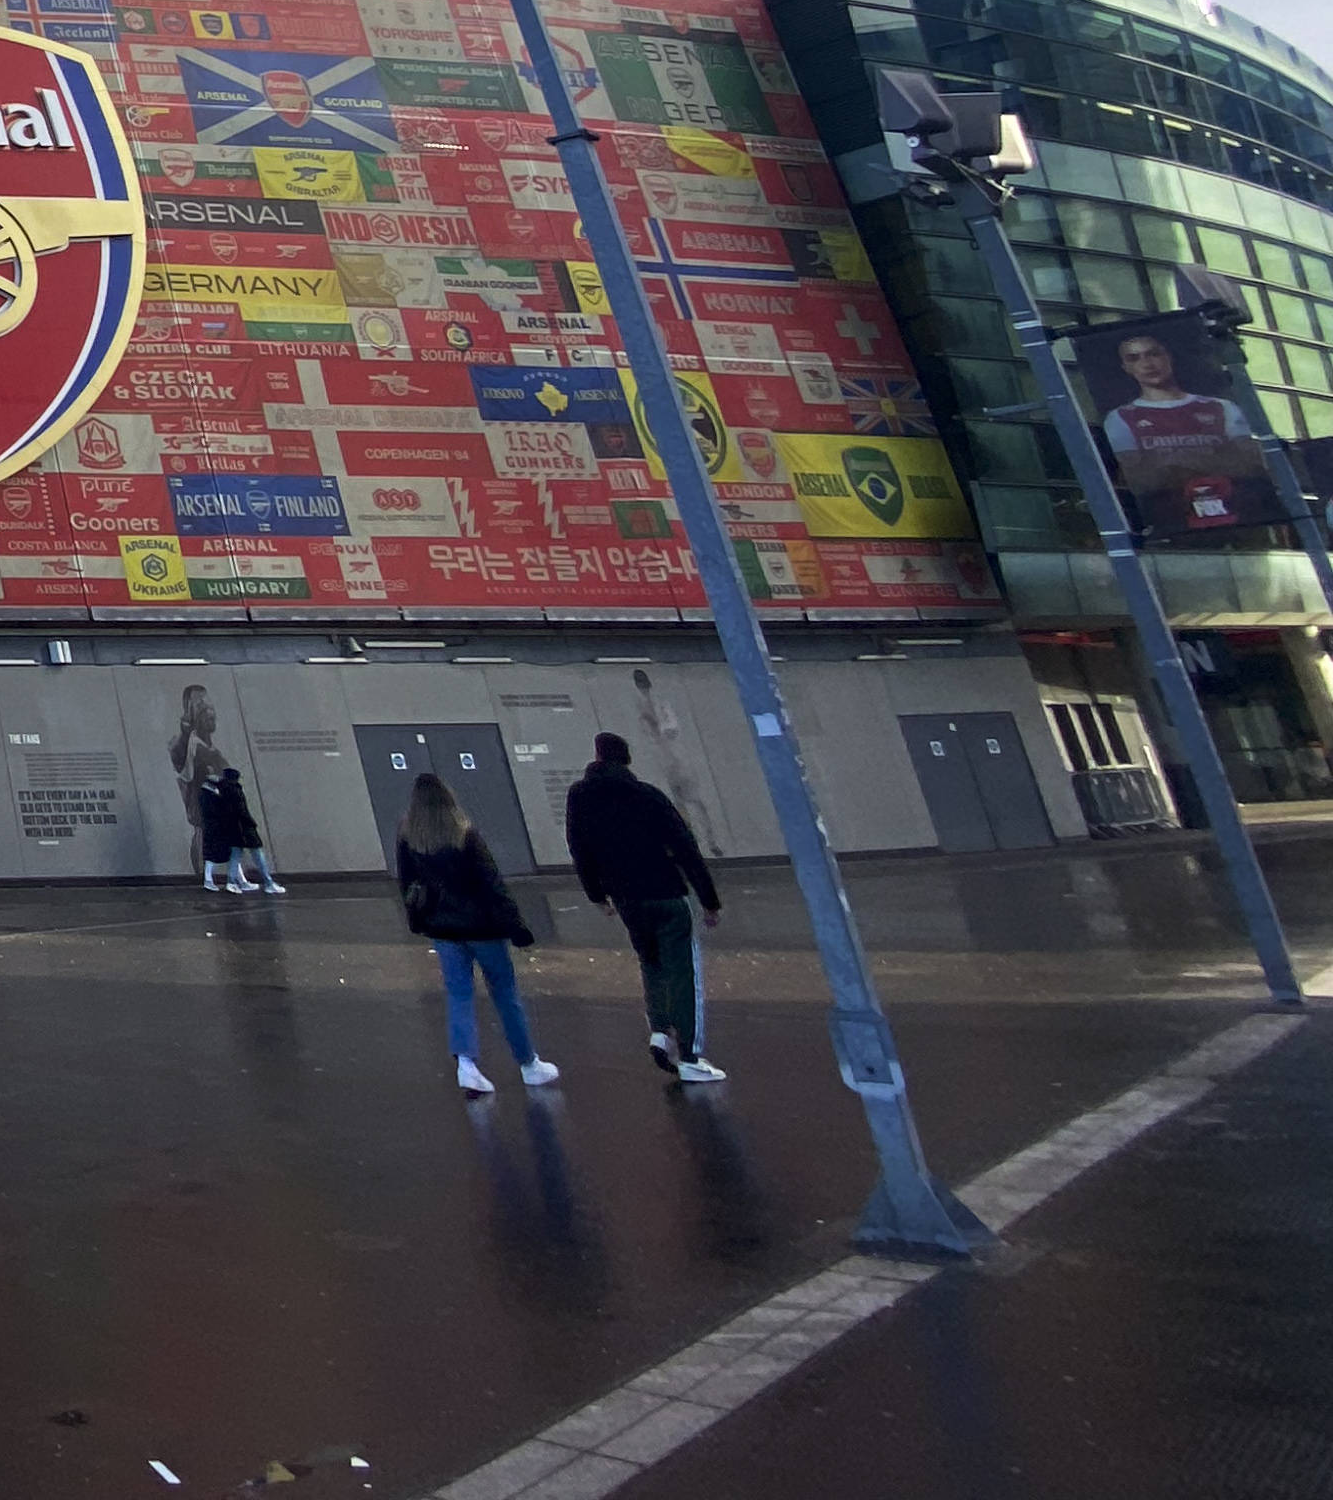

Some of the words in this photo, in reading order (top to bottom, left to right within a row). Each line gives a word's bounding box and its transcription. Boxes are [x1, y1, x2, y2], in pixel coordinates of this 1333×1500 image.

[370, 27, 455, 43] YORKSHIRE
[282, 151, 326, 164] ARSENAL
[142, 271, 323, 296] GERMANY
[701, 292, 796, 315] NORWAY
[425, 309, 478, 323] ARSENAL
[517, 316, 592, 330] ARSENAL
[195, 343, 231, 354] CLUB
[257, 342, 350, 357] LITHUANIA
[129, 370, 214, 384] CZECH
[113, 385, 130, 399] &
[134, 385, 236, 400] SLOVAK
[175, 494, 246, 518] ARSENAL
[274, 496, 341, 518] FINLAND
[69, 511, 160, 532] Gooners
[124, 539, 177, 554] ARSENAL
[202, 539, 278, 554] ARSENAL
[428, 544, 516, 582] 우리는
[519, 544, 607, 582] 잠들지
[132, 581, 187, 597] UKRAINE
[206, 581, 291, 596] HUNGARY
